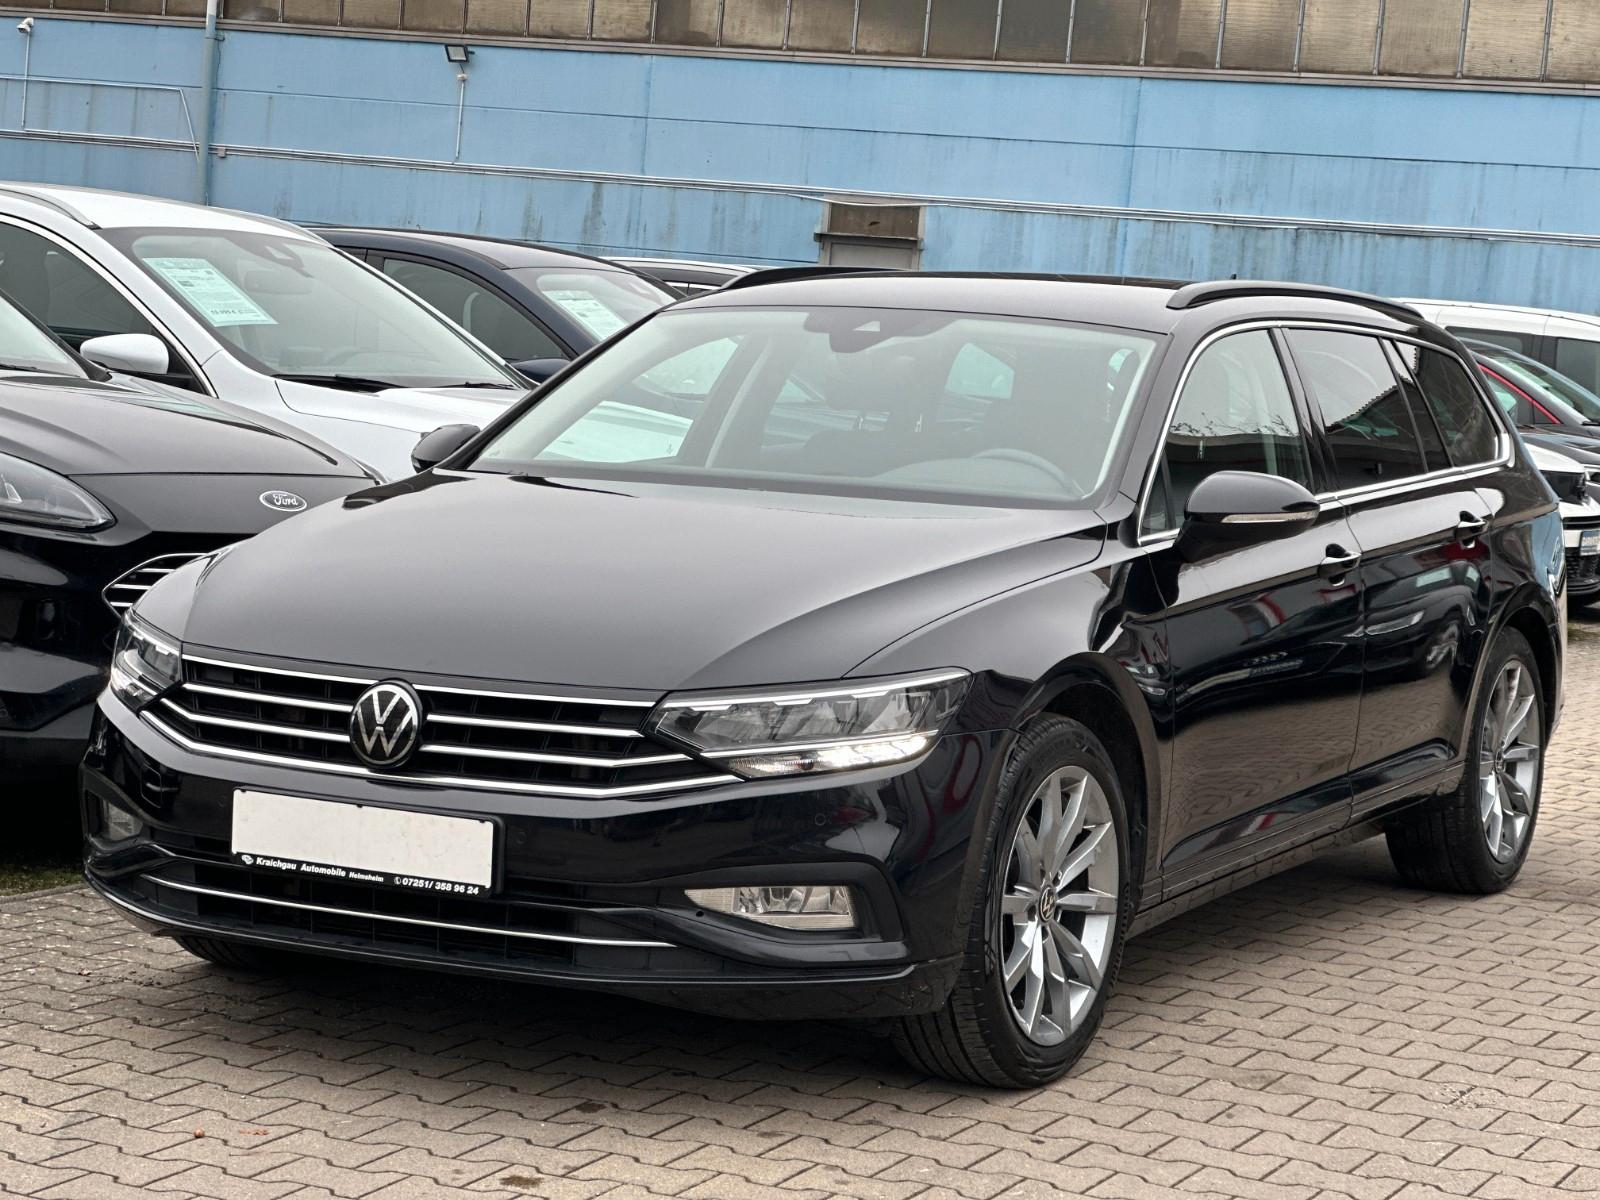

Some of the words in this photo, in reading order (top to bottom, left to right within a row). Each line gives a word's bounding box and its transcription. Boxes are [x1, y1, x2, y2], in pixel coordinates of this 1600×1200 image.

[273, 493, 299, 506] Ford
[354, 686, 416, 760] VW
[256, 857, 297, 871] Kraichgau
[300, 863, 346, 877] Automobile
[402, 877, 434, 889] 07251/
[434, 881, 452, 892] 358
[453, 884, 465, 893] 96
[466, 886, 479, 895] 24
